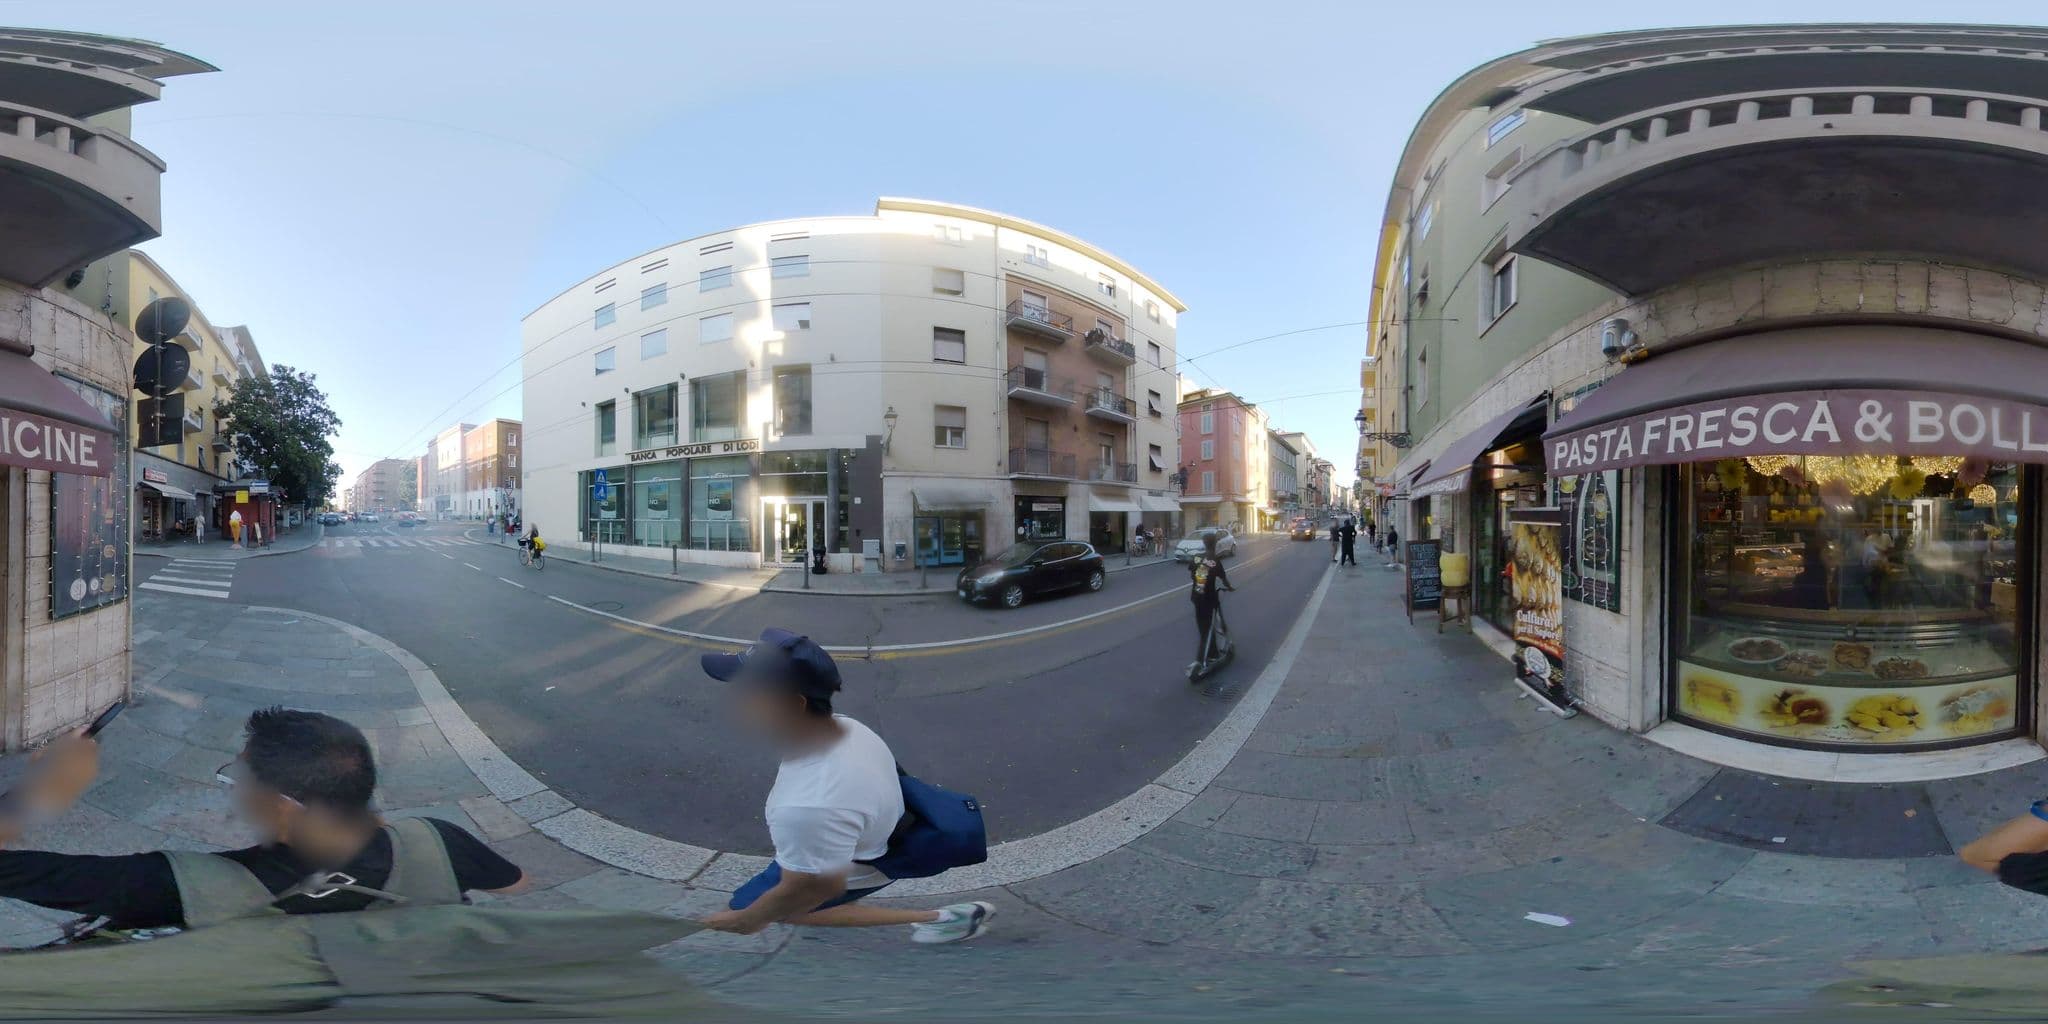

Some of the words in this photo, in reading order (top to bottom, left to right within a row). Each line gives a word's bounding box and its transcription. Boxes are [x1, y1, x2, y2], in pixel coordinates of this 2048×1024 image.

[1, 417, 98, 470] ICINE
[631, 452, 657, 462] BANCA
[666, 445, 712, 458] POPOLARE
[723, 443, 734, 453] DI
[736, 440, 760, 452] LODI
[1553, 425, 1633, 470] PASTA
[1640, 400, 1841, 455] FRESCA
[1854, 400, 1893, 443] &
[1908, 401, 2048, 451] BOLL
